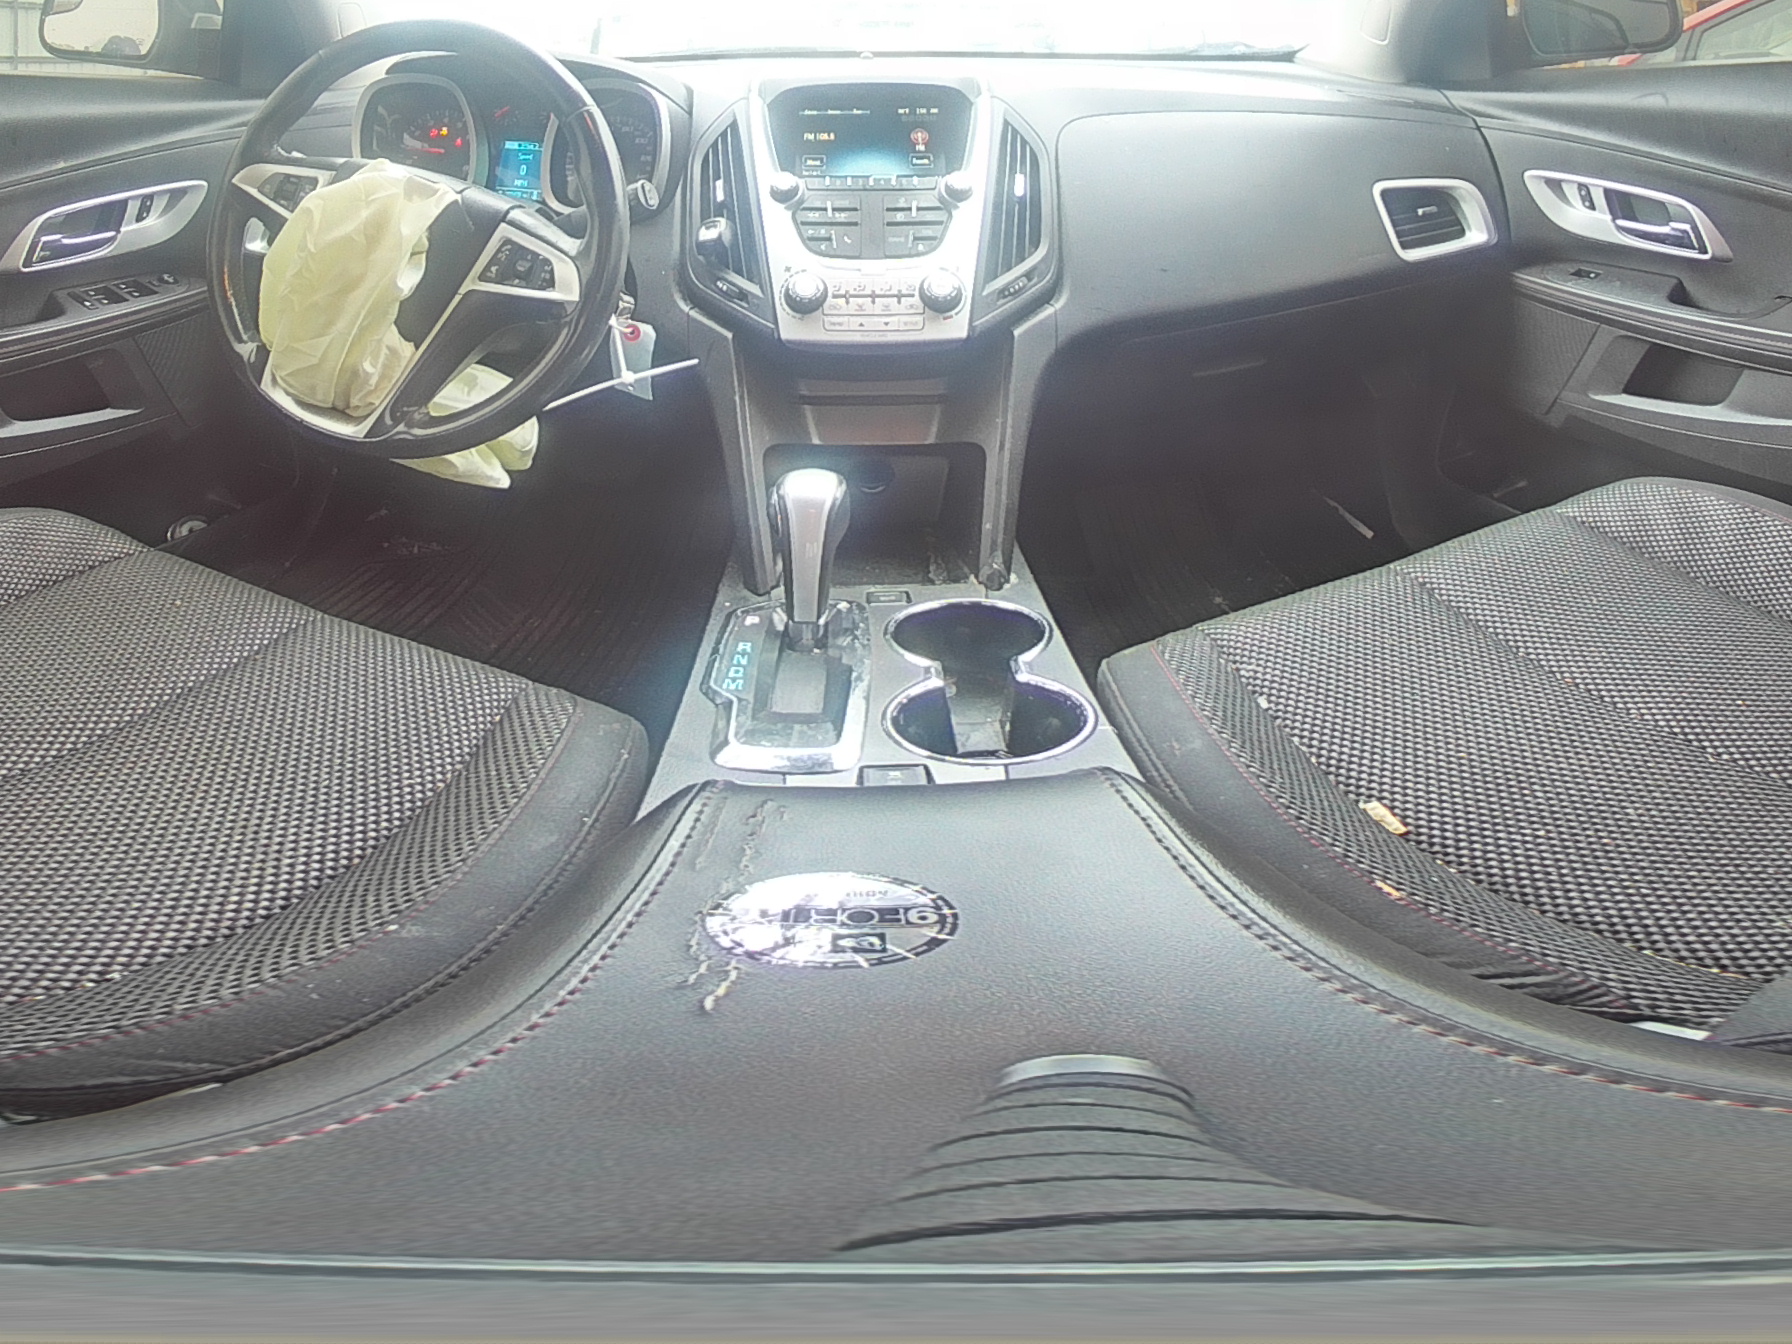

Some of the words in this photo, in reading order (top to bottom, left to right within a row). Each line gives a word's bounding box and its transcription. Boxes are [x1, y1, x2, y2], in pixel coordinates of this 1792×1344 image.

[736, 641, 752, 653] R
[732, 654, 748, 665] N
[728, 666, 744, 678] D
[722, 678, 744, 690] M
